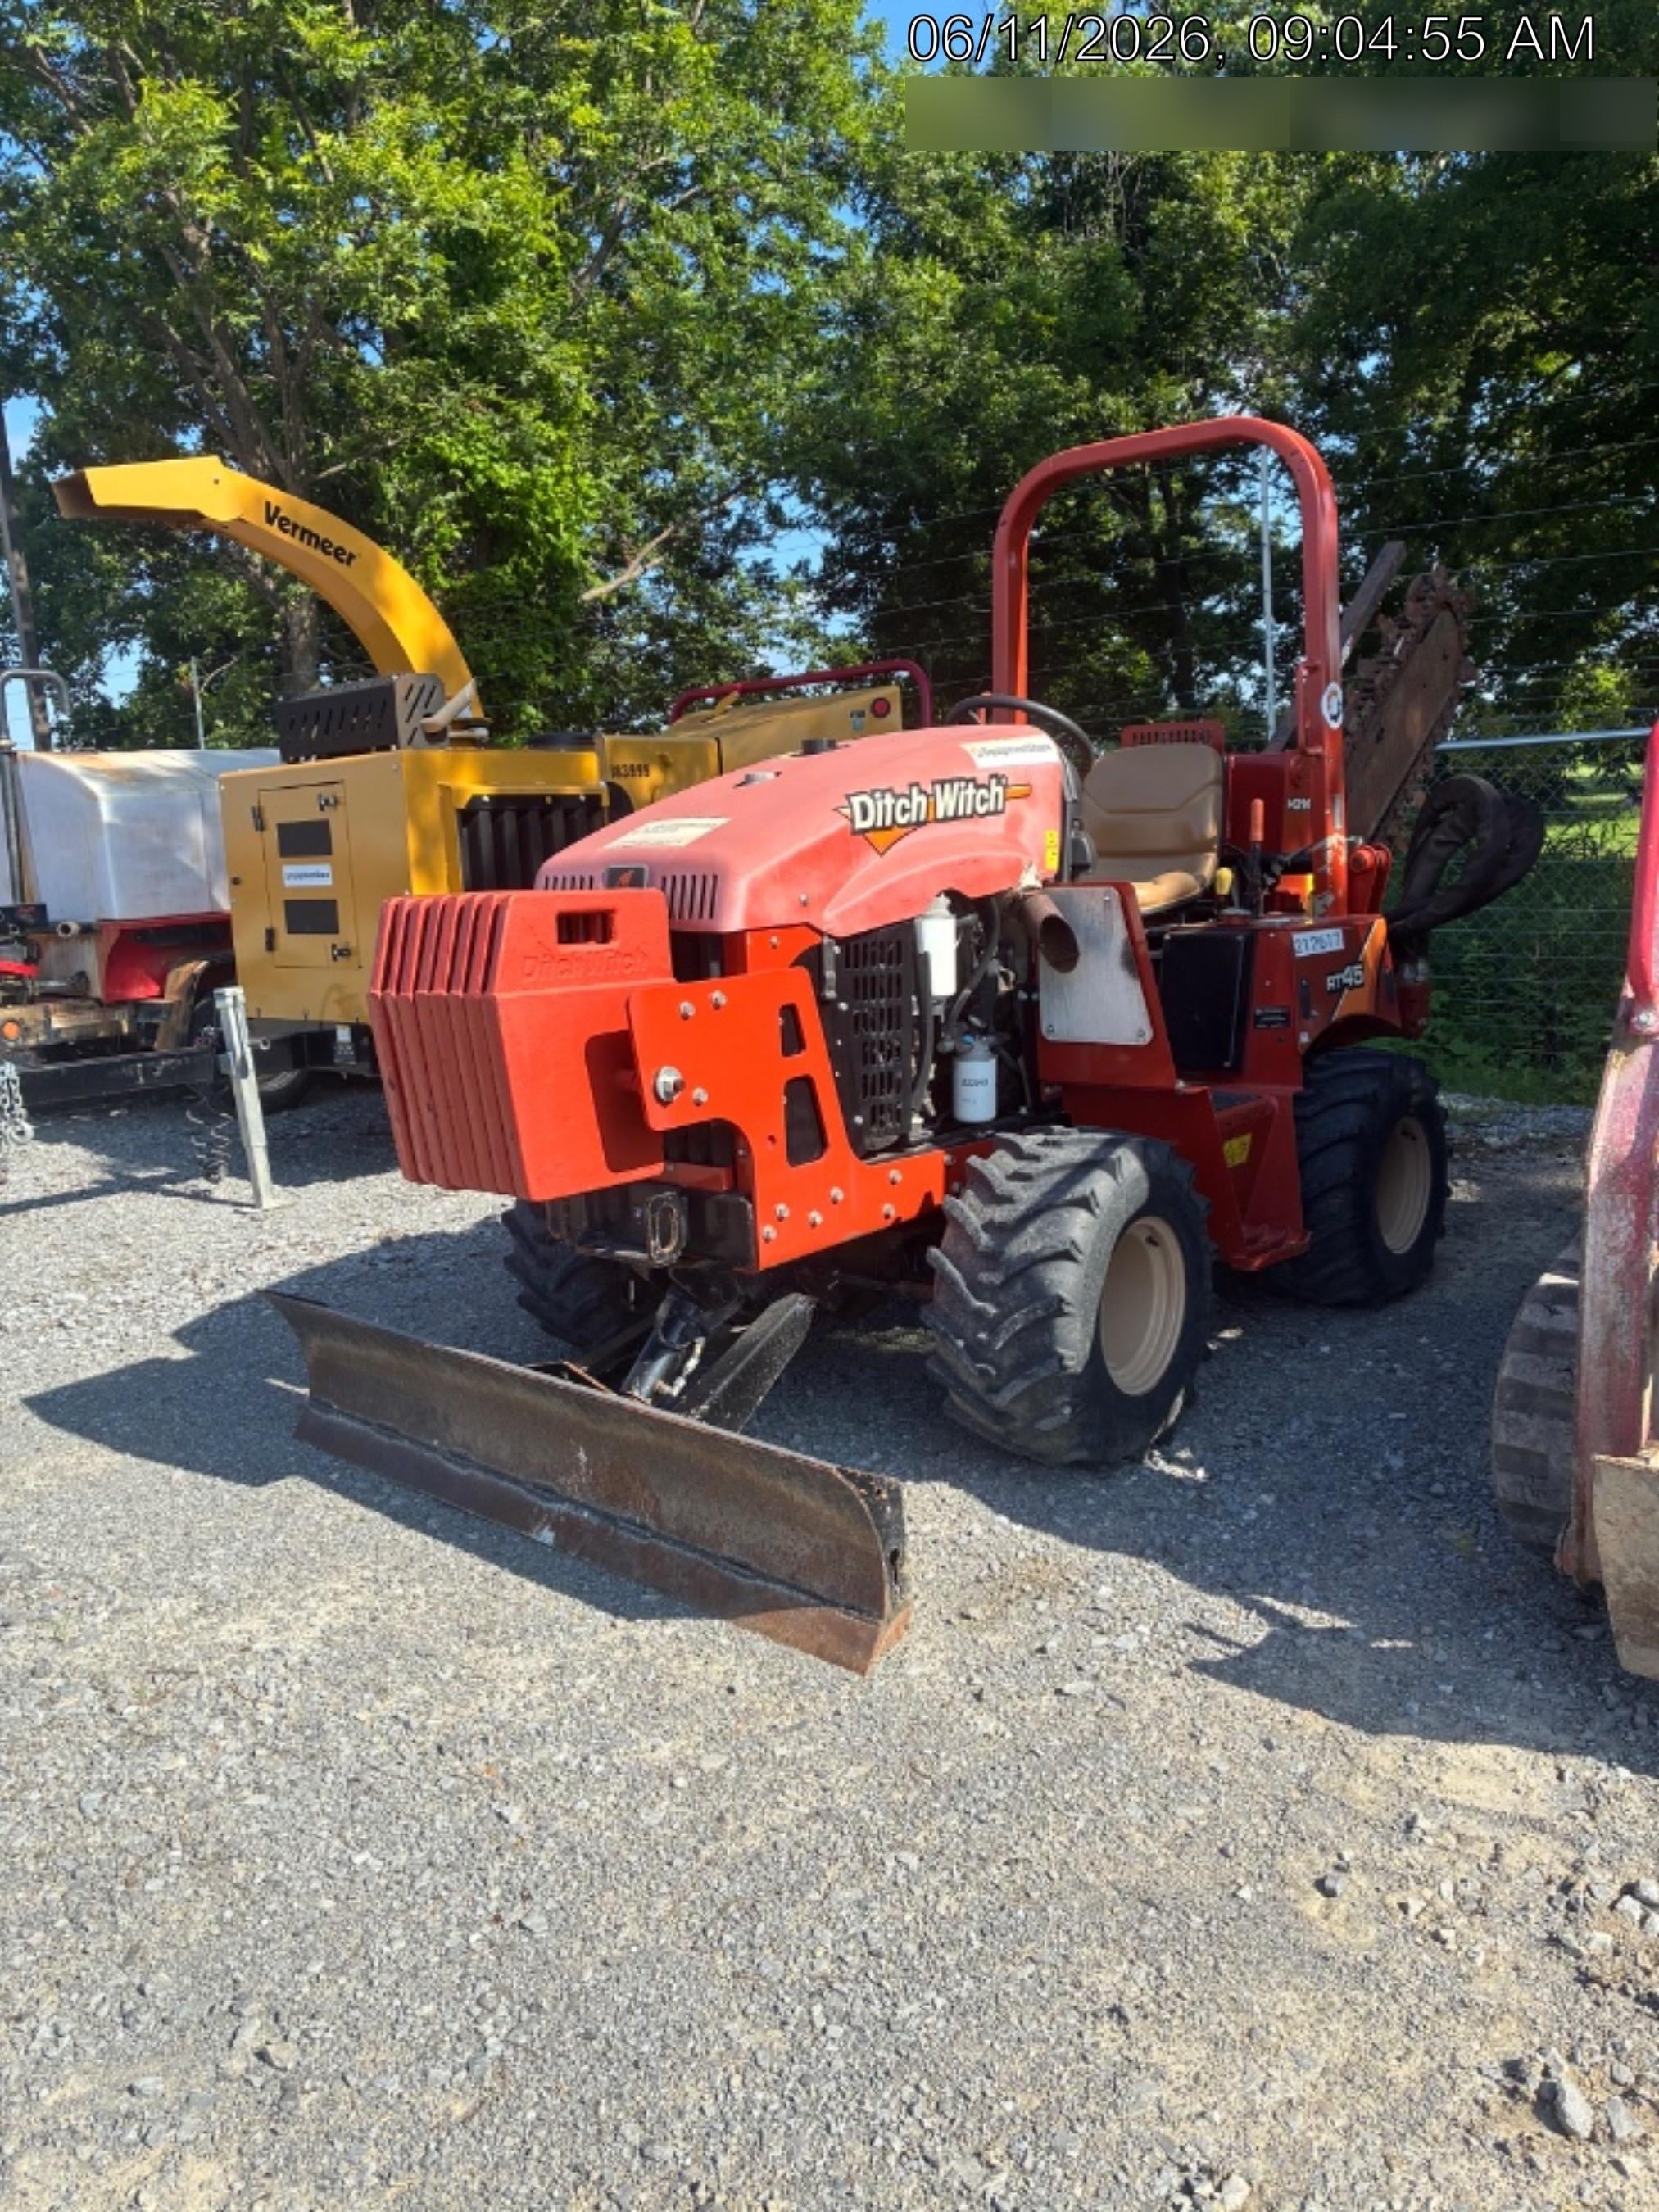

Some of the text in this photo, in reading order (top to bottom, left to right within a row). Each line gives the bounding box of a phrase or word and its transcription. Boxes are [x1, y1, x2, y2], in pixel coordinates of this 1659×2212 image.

[265, 500, 357, 567] Vermeer
[846, 773, 1007, 834] Ditch Witch
